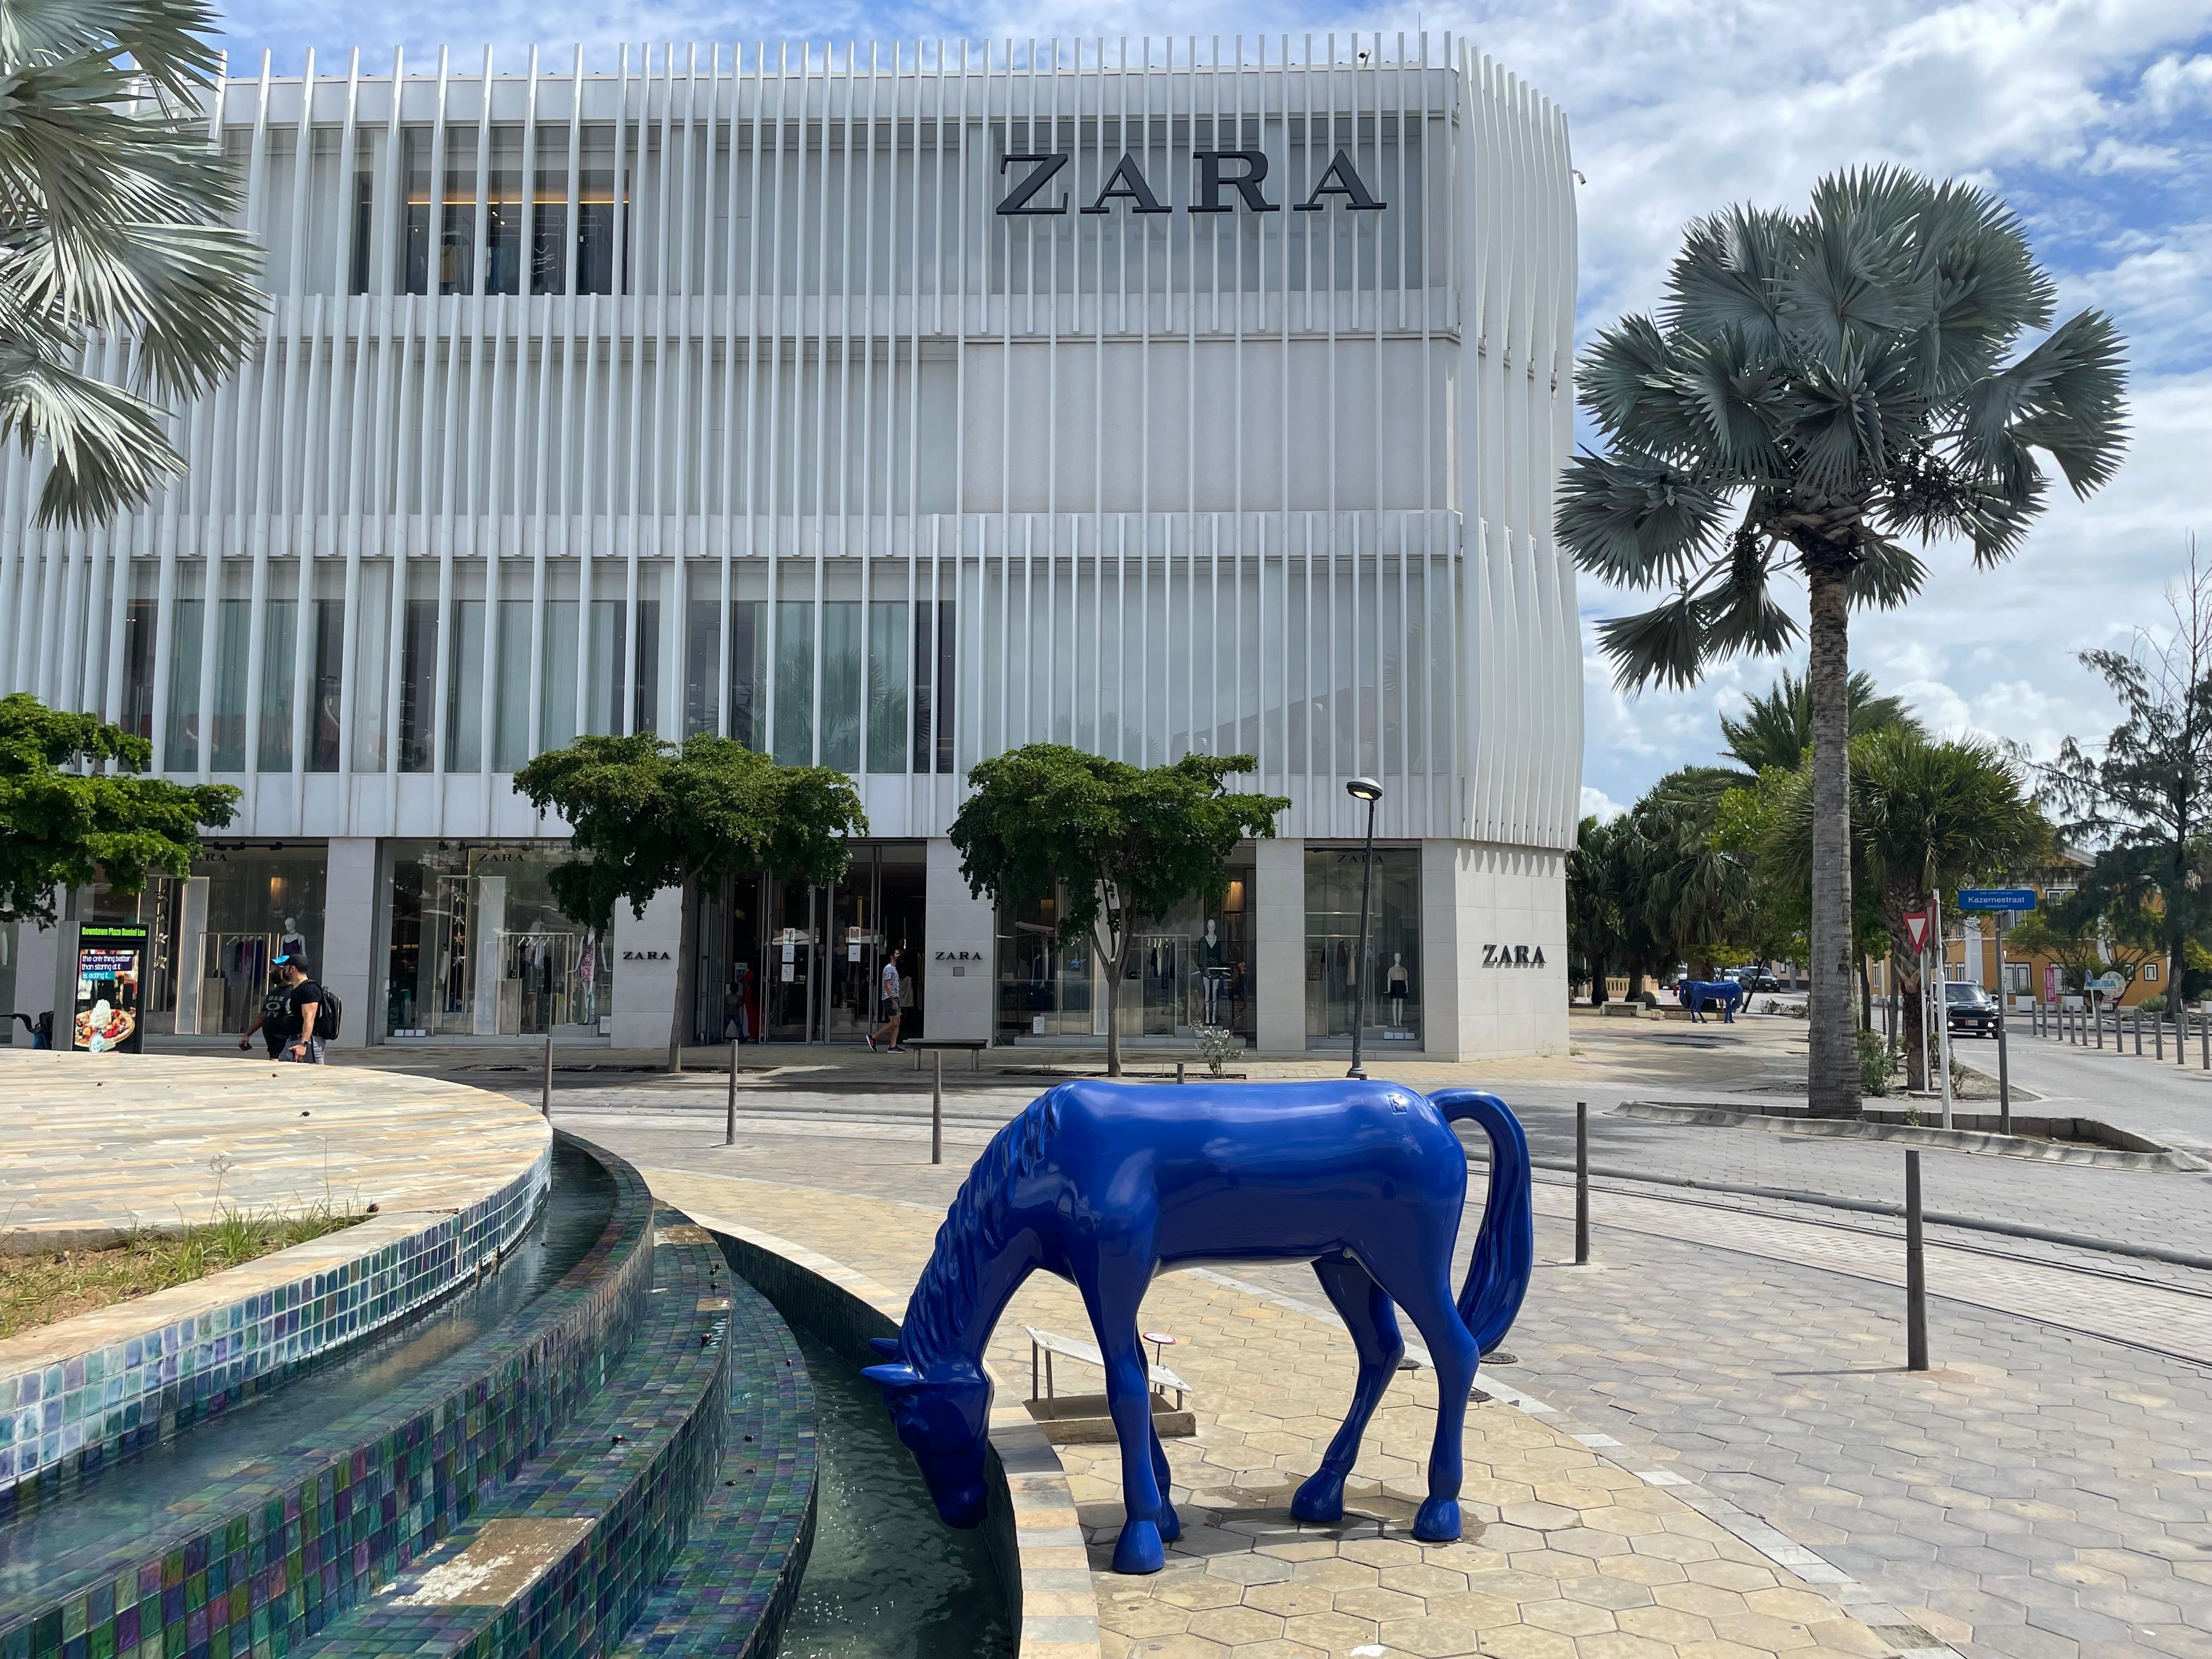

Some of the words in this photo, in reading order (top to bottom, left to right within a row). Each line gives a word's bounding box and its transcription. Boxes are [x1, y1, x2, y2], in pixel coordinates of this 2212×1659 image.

[996, 150, 1387, 215] ZARA
[82, 927, 108, 935] Downtown
[109, 927, 121, 936] Plaza
[623, 951, 671, 960] ZARA
[935, 951, 983, 960] ZARA
[1482, 944, 1547, 963] ZARA
[88, 972, 104, 980] eating
